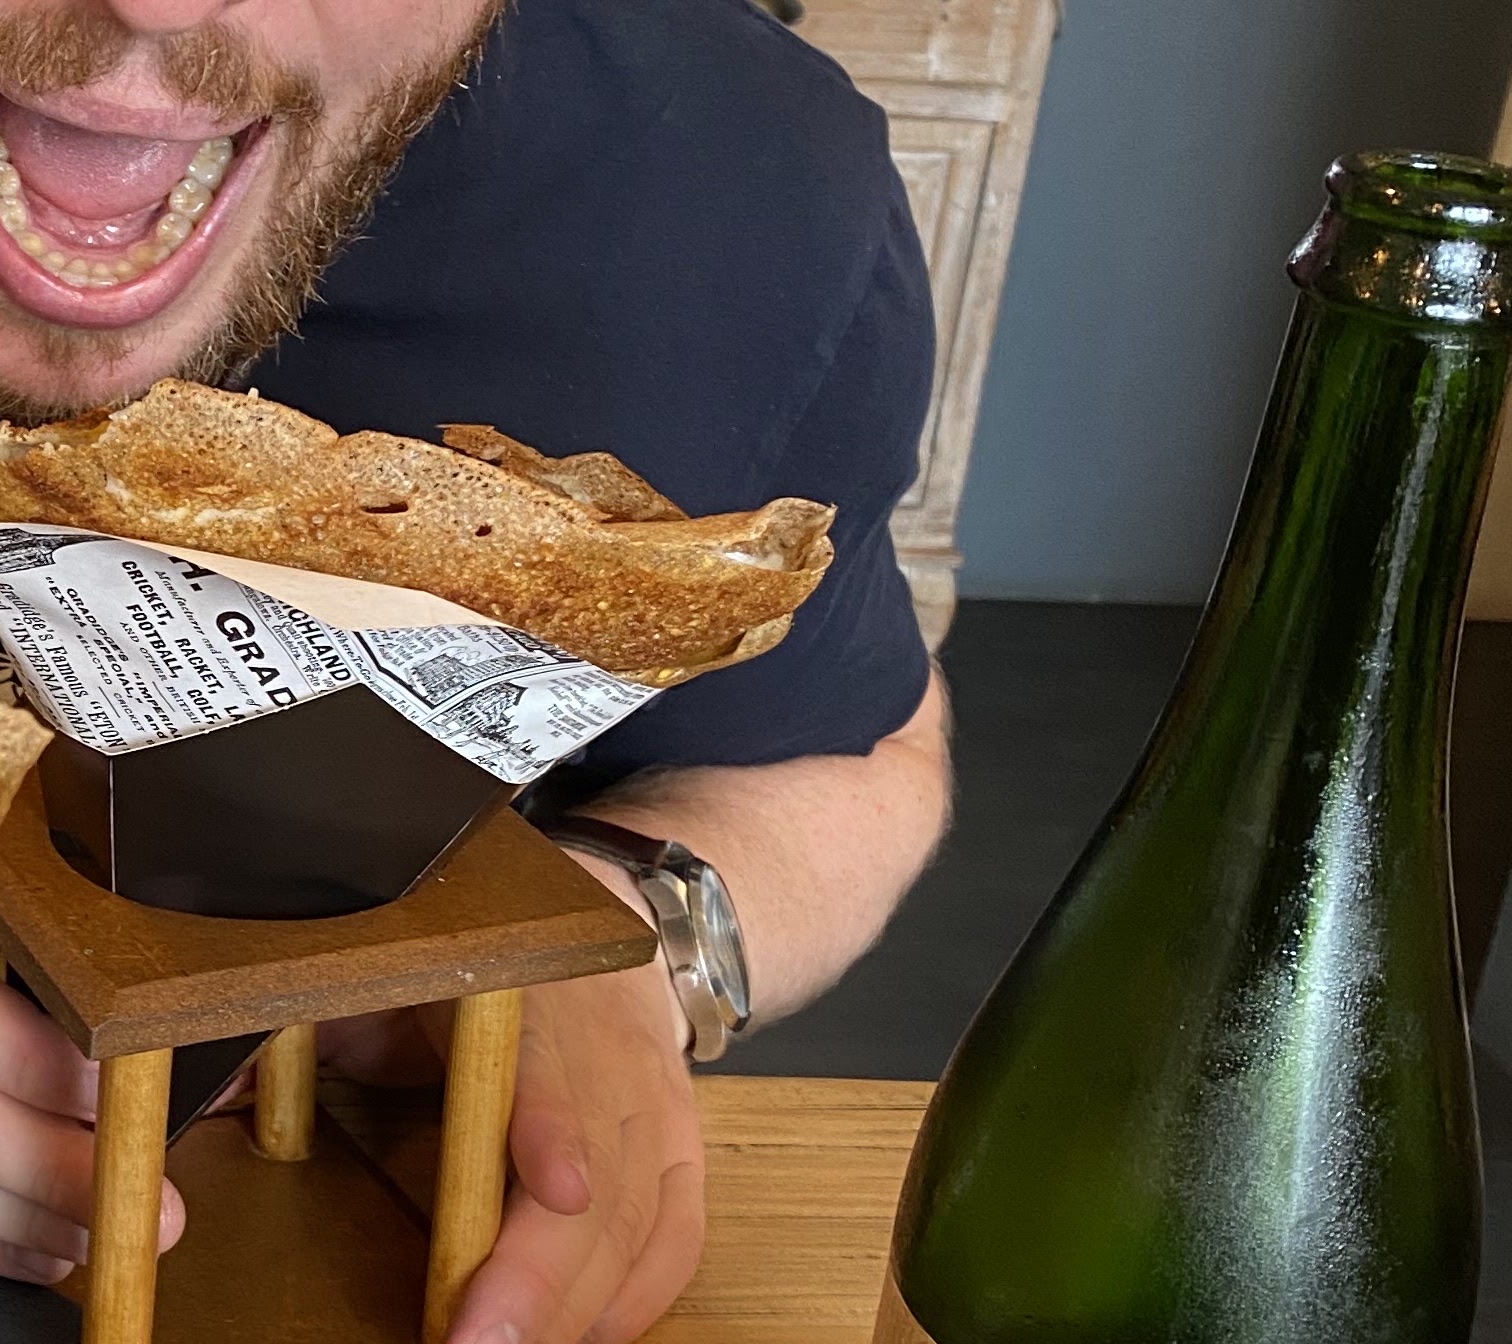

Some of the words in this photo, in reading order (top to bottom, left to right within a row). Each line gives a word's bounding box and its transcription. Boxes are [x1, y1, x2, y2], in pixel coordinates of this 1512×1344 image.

[46, 645, 89, 698] Famous
[119, 621, 139, 643] AND
[139, 647, 168, 682] OTHER
[121, 560, 175, 626] CRICKET,
[174, 637, 225, 694] RACKET,
[126, 603, 184, 679] FOOTBALL,
[186, 689, 222, 725] GOLF,
